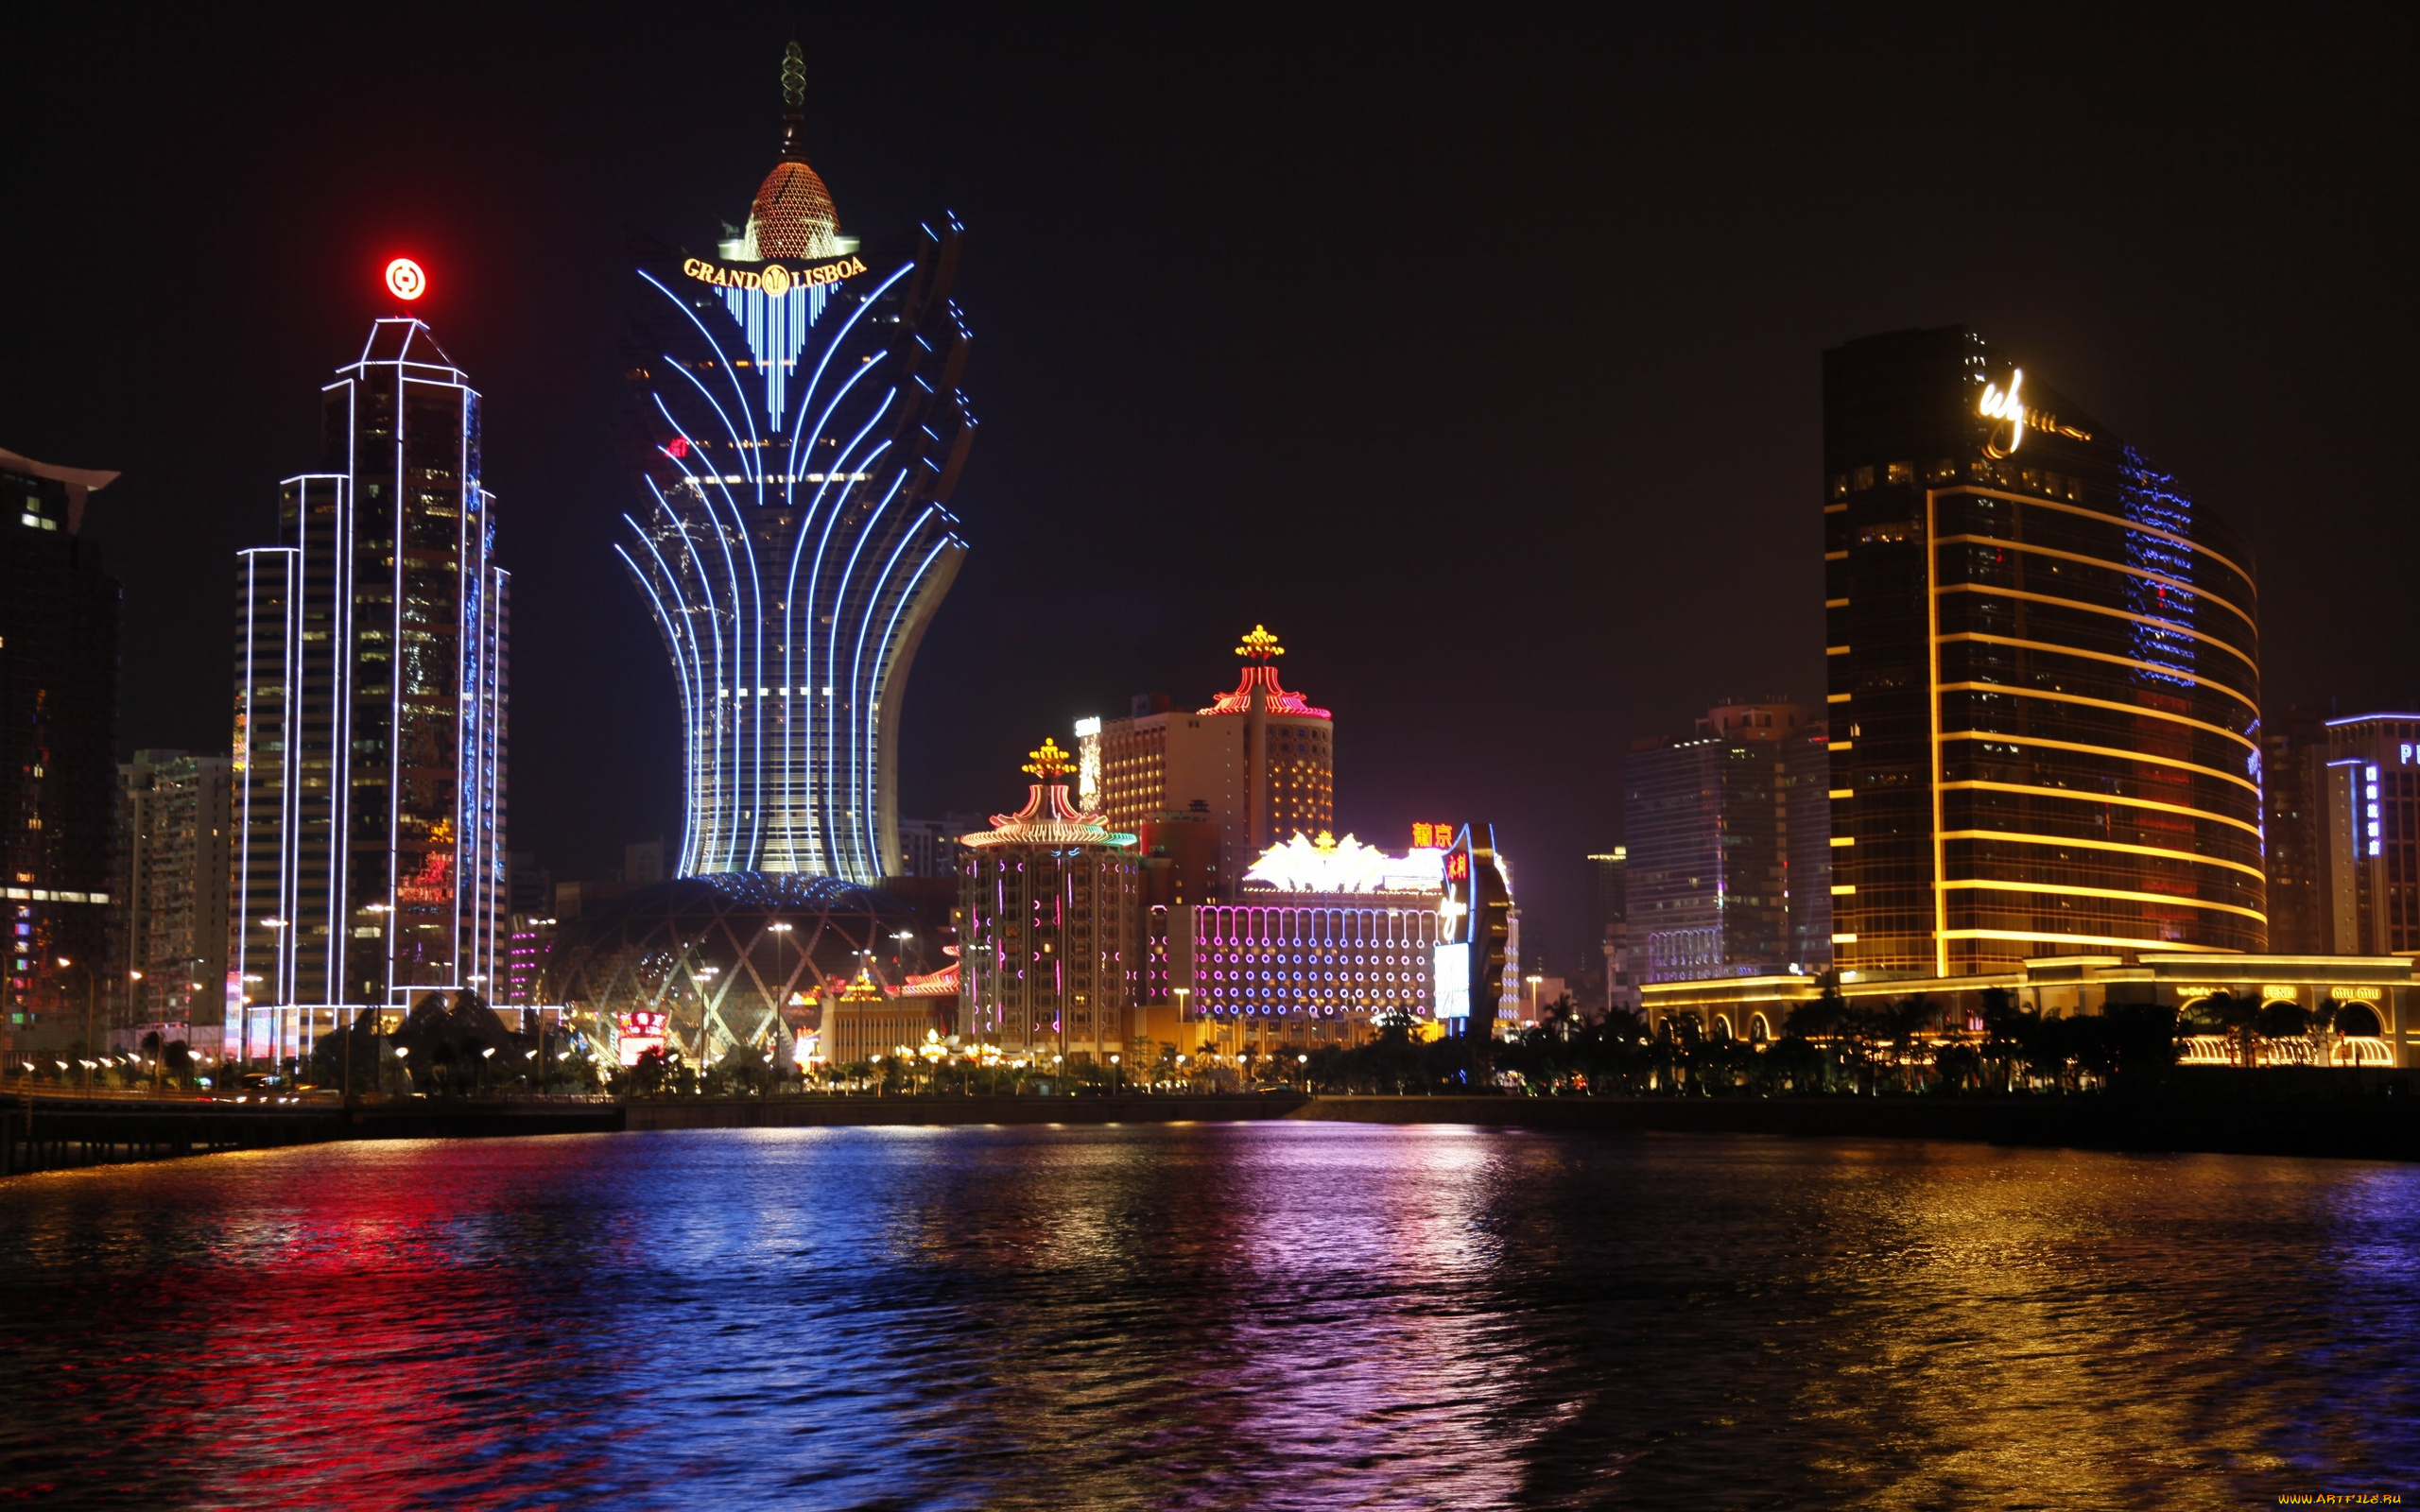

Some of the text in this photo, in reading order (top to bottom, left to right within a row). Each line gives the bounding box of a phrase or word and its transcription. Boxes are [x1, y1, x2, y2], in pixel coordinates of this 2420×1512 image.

[683, 256, 868, 290] GRAND LISBOA
[2264, 987, 2296, 999] FENDI
